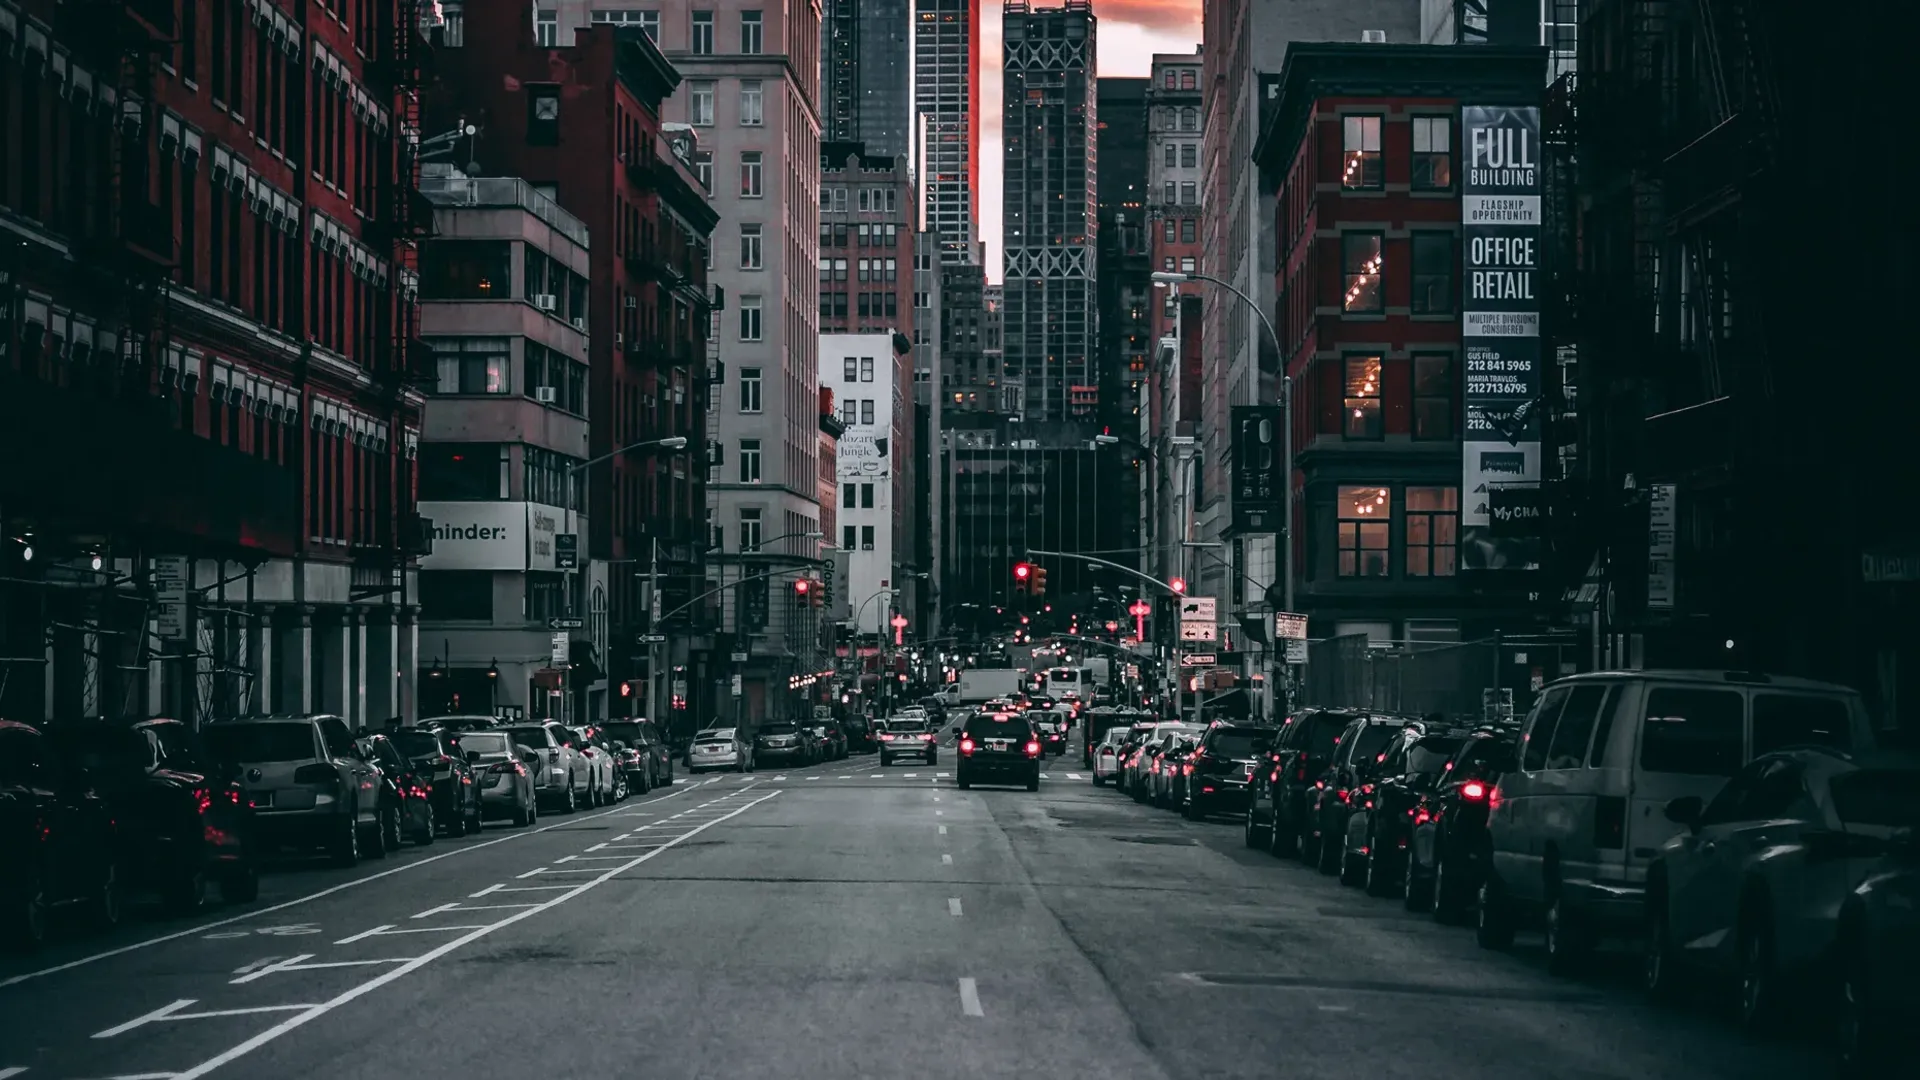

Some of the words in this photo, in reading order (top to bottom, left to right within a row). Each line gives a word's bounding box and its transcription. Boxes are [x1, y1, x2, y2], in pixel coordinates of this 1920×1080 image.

[1472, 128, 1534, 168] FULL
[1471, 169, 1534, 186] BUILDING
[1481, 199, 1524, 210] FLAGSHIP
[1472, 209, 1532, 220] OPPORTUNITY
[1471, 237, 1534, 265] OFFICE
[1473, 271, 1534, 299] RETAIL
[1469, 314, 1501, 324] MULTIPLE
[1502, 314, 1537, 324] DIVISIONS
[1481, 324, 1523, 334] CONSIDERED
[1467, 352, 1481, 360] GUS
[1482, 352, 1500, 360] FIELD
[1467, 361, 1486, 371] 212
[1487, 361, 1505, 371] 841
[1507, 361, 1532, 371] 5965
[1467, 375, 1489, 383] MARIA
[1467, 383, 1486, 393] 212
[1486, 383, 1503, 393] 713
[1504, 383, 1528, 393] 6795
[1467, 419, 1486, 430] 212
[840, 433, 873, 443] Mozart
[839, 446, 872, 459] Jungle
